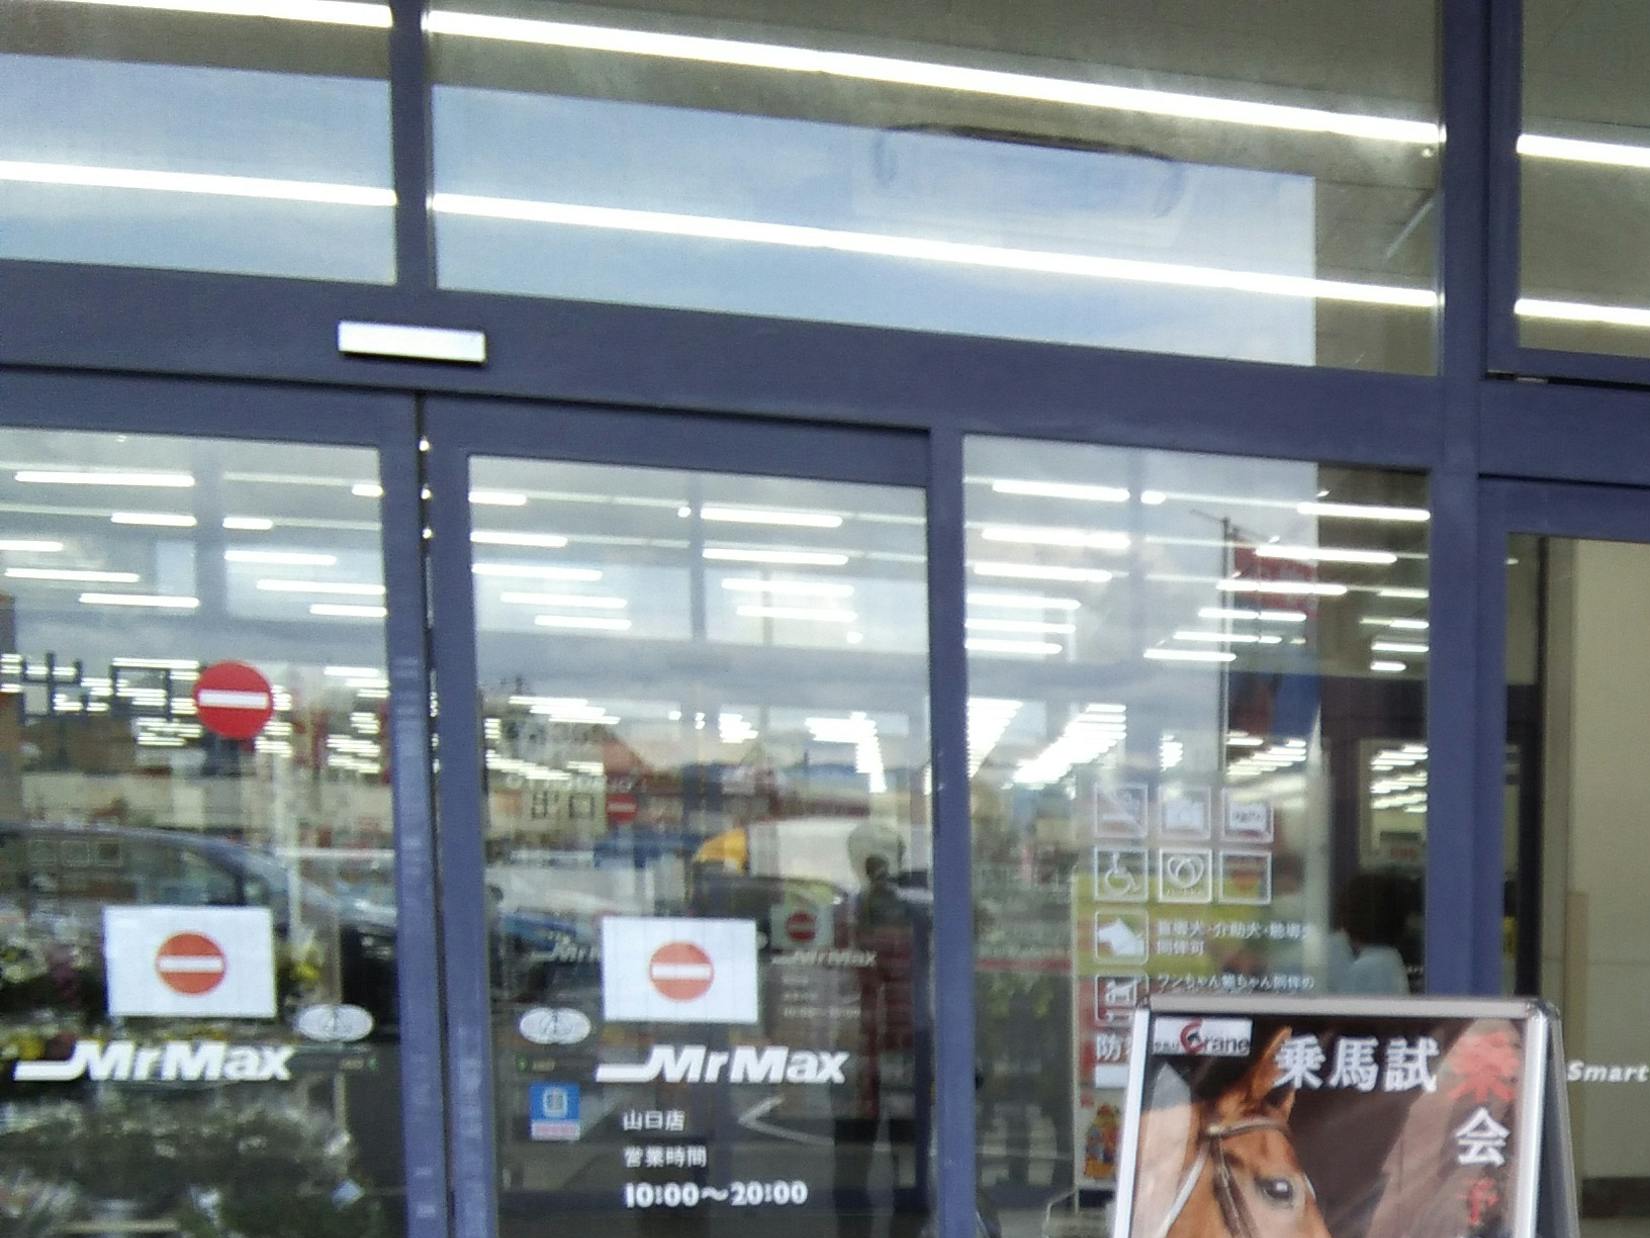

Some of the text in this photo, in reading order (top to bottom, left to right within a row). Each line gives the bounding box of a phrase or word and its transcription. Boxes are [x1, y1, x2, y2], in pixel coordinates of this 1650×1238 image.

[13, 1040, 296, 1083] MrMax
[595, 1044, 849, 1083] MrMax
[1566, 1061, 1649, 1084] Smart
[623, 1110, 686, 1131] 山口店
[624, 1146, 707, 1168] 営業時間
